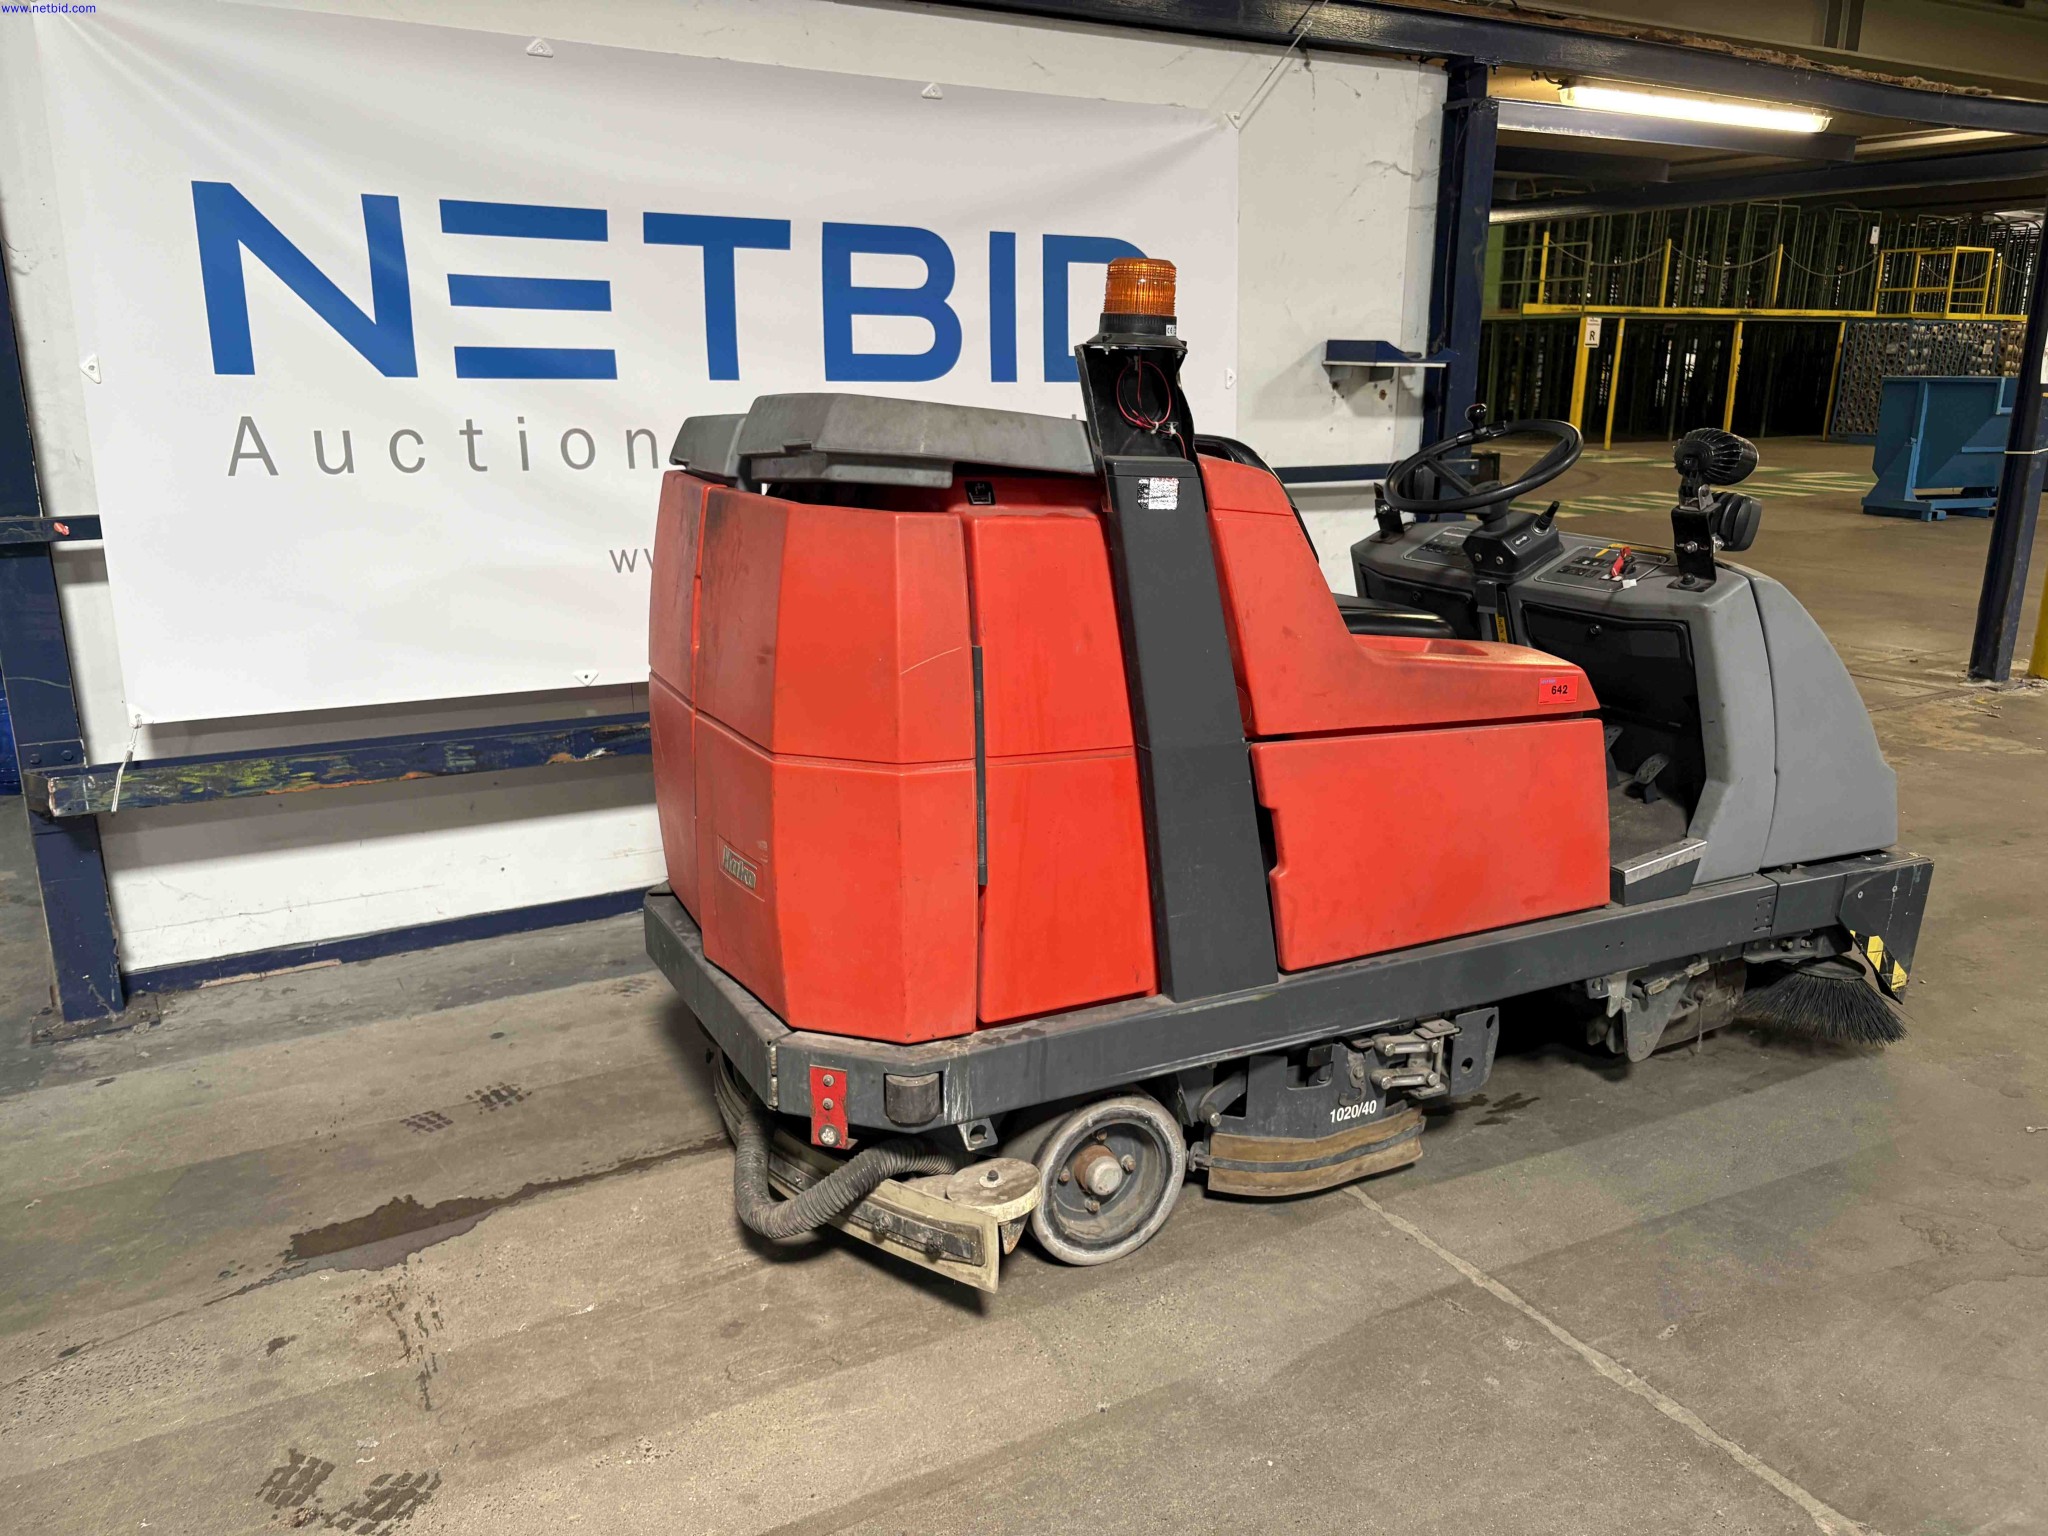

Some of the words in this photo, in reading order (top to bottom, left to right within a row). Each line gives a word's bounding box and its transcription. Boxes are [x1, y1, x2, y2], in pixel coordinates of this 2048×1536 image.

[191, 181, 1150, 382] NETBID
[1589, 330, 1596, 341] R
[1551, 684, 1568, 695] 642
[1330, 1099, 1377, 1123] 1020/40
